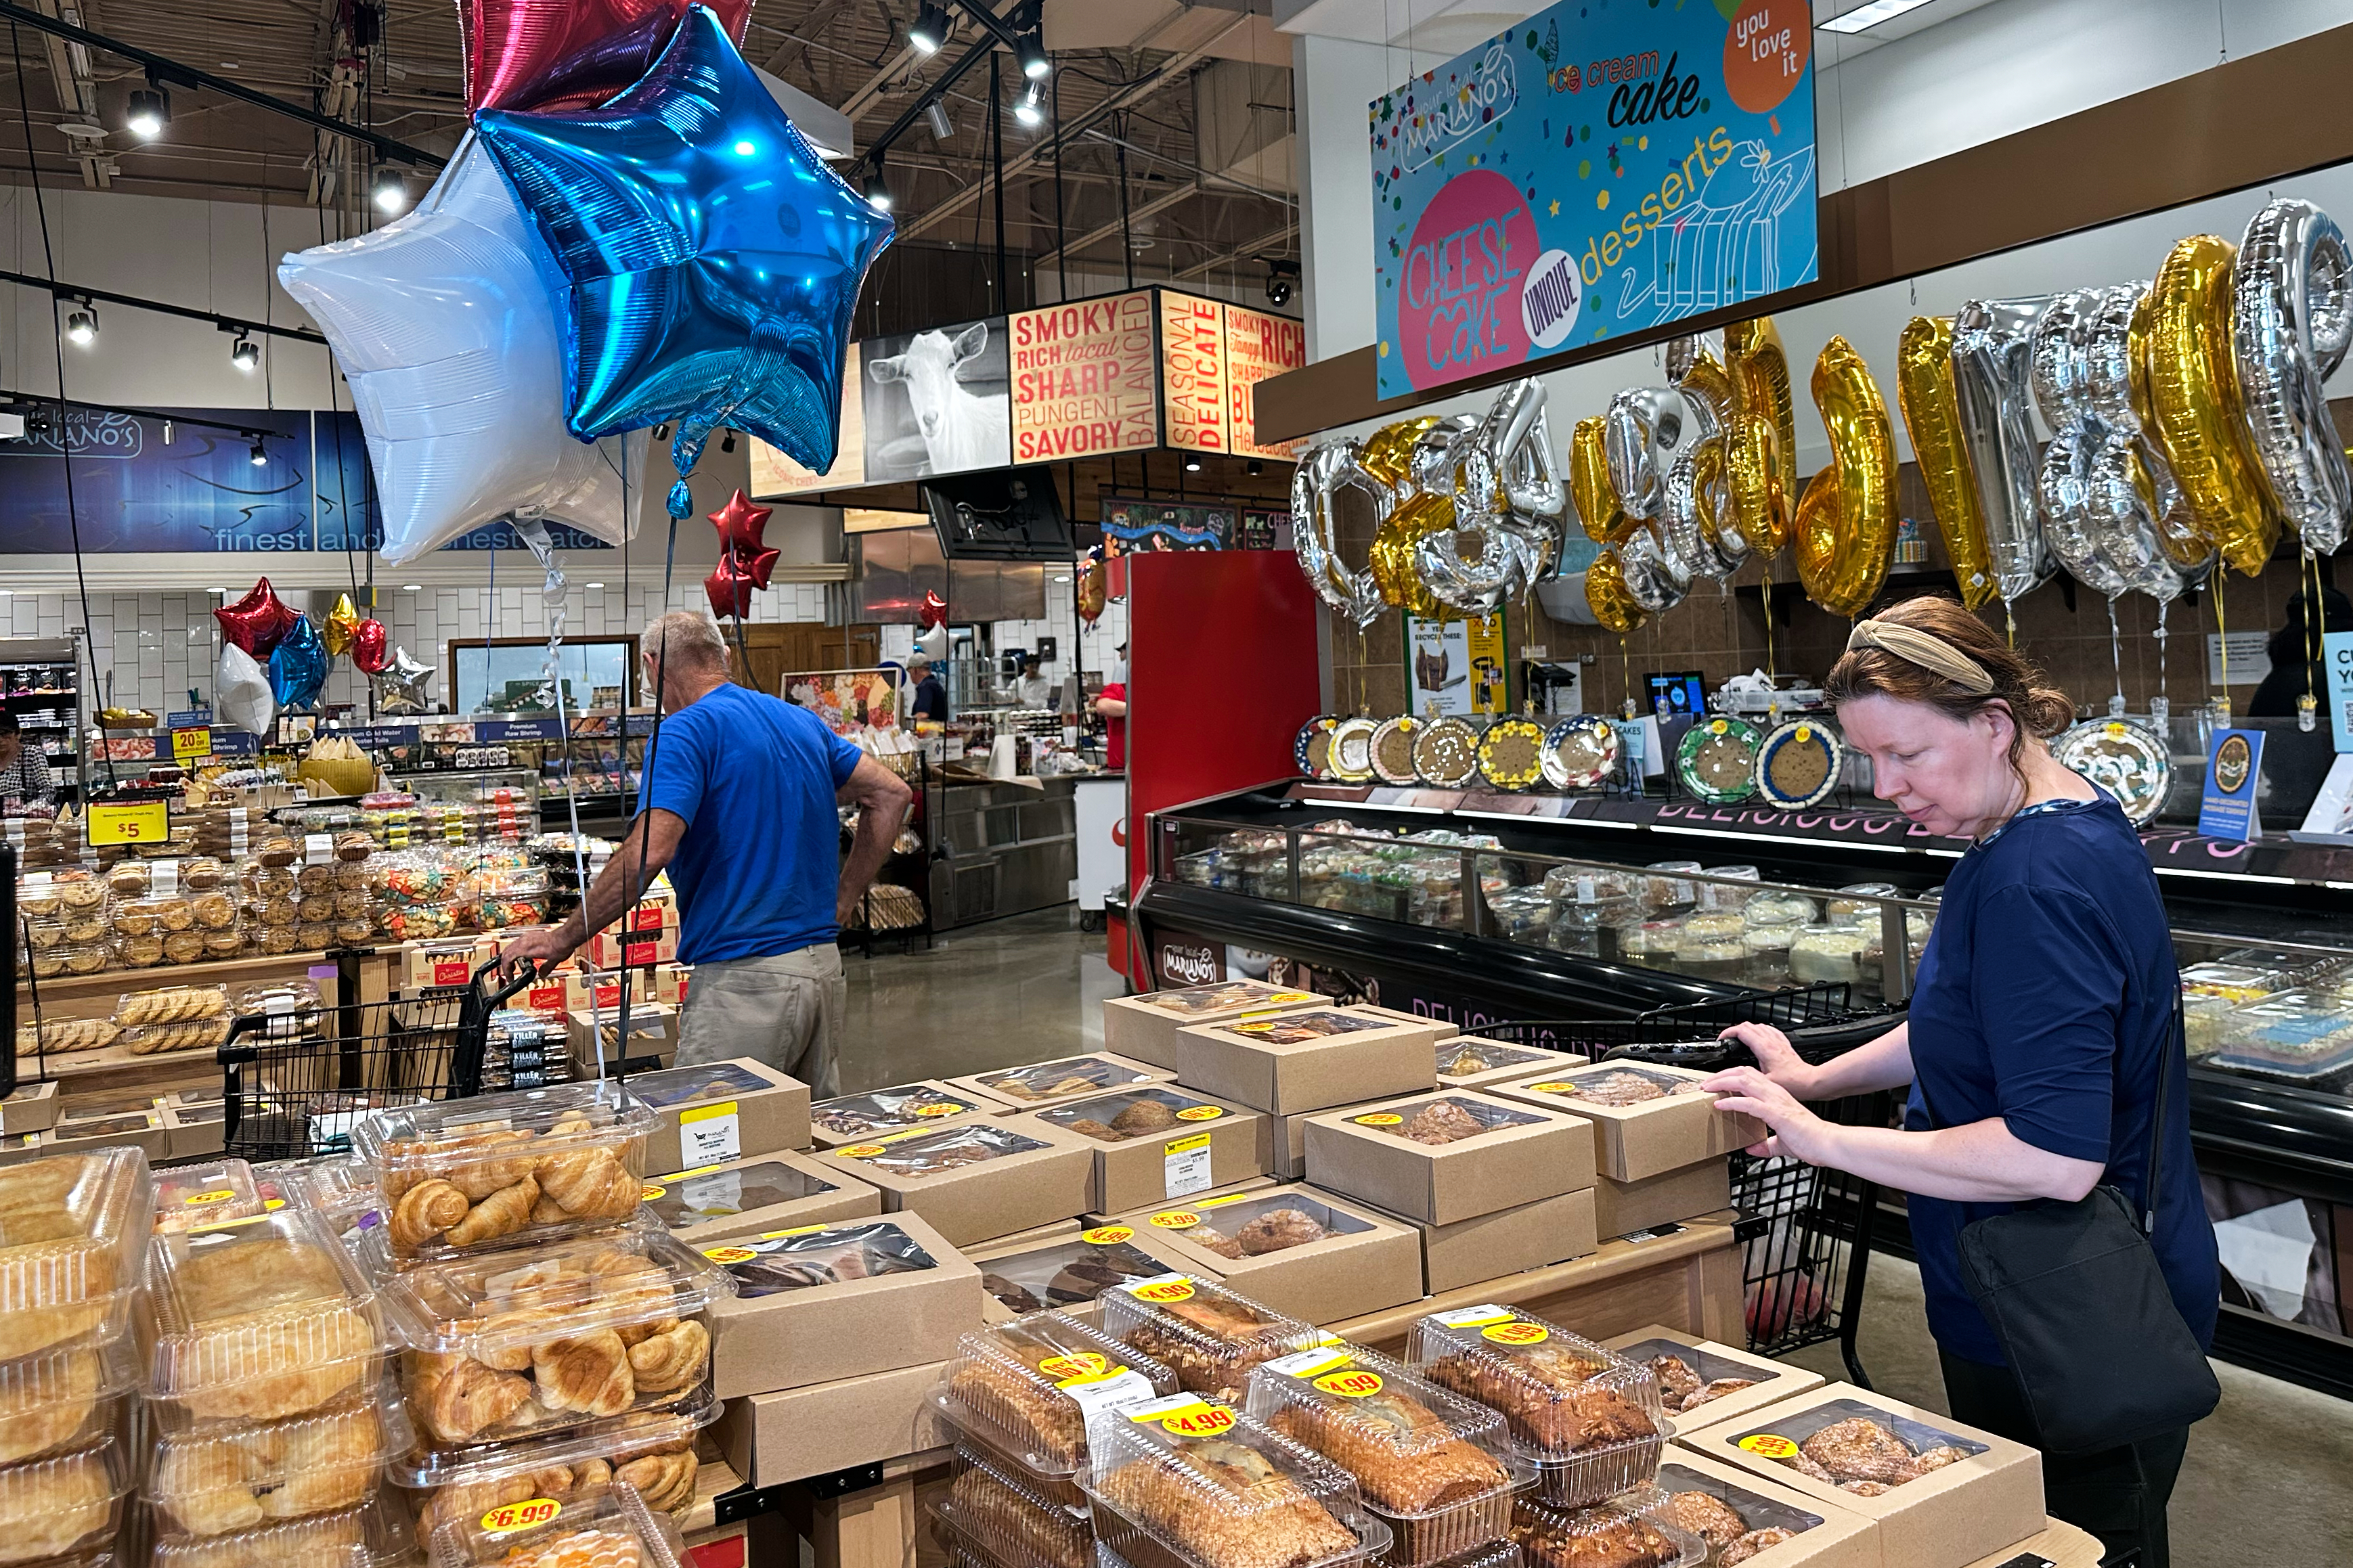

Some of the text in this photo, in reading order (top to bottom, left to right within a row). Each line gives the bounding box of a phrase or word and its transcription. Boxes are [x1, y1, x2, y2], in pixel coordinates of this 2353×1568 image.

[1736, 9, 1769, 48] you
[1751, 28, 1791, 62] love
[1586, 50, 1660, 88] cream
[1782, 51, 1797, 77] it
[1414, 64, 1473, 115] your local
[1607, 51, 1700, 129] cake
[1406, 64, 1510, 157] MARIANO'S
[1581, 125, 1734, 286] desserts
[1407, 206, 1522, 309] CHEESE
[1524, 255, 1578, 338] UNIQUE
[1016, 300, 1118, 346] SMOKY
[1228, 310, 1261, 336] SMOKY
[1017, 335, 1120, 370] RICH local
[1229, 331, 1260, 363] Tangy
[1261, 318, 1306, 367] RICH
[1018, 360, 1120, 404] SHARP
[1122, 296, 1154, 446] BALANCED
[1168, 300, 1197, 445] SEASONAL
[1193, 302, 1221, 449] DELICATE
[1231, 361, 1262, 384] SHARP
[53, 409, 89, 424] local
[1019, 395, 1123, 428] PUNGENT
[1019, 420, 1122, 460] SAVORY
[215, 527, 309, 551] finest
[321, 527, 380, 551] and
[520, 729, 543, 738] Shrimp
[1617, 725, 1642, 736] CAKES
[438, 968, 466, 982] Christie
[533, 992, 560, 1007] Christie
[512, 1031, 538, 1040] KILLER
[512, 1037, 542, 1049] BROWNIE
[514, 1050, 539, 1060] KILLER
[514, 1070, 540, 1081] KILLER
[1153, 1214, 1198, 1226] $5.99
[1090, 1228, 1131, 1242] $4.99
[1137, 1284, 1192, 1299] $4.99
[1486, 1324, 1544, 1341] $4.99
[1316, 1374, 1380, 1393] $4.99
[1167, 1410, 1233, 1432] $4.99
[489, 1503, 554, 1527] $6.99
